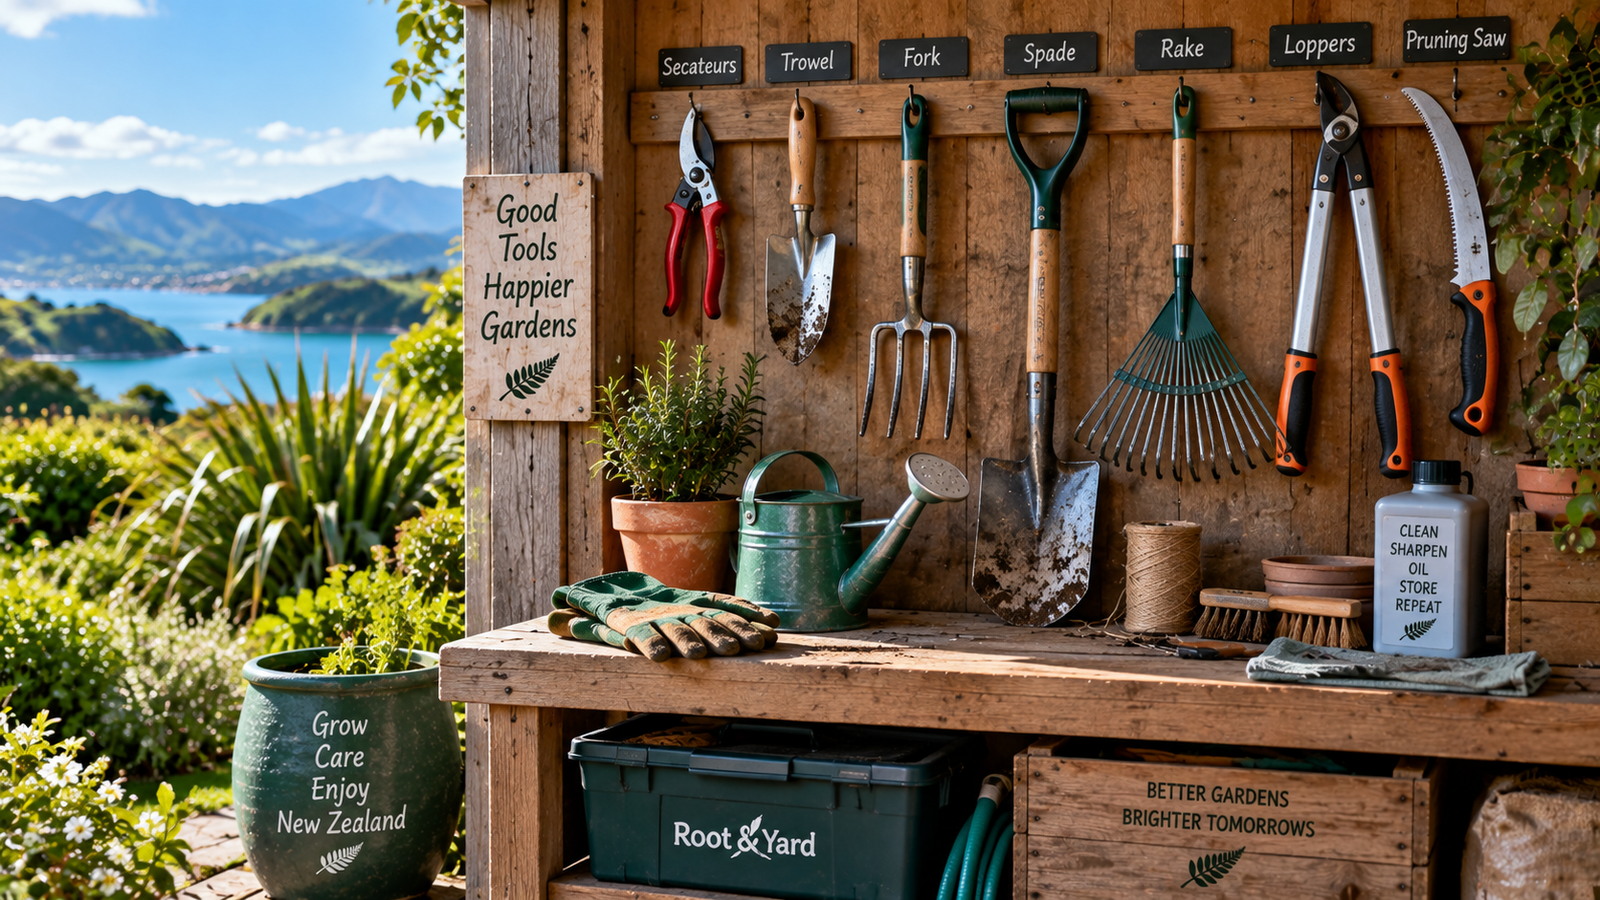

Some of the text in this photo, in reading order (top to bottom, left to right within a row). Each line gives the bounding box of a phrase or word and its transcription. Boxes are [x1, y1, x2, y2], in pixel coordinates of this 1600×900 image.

[1162, 37, 1203, 58] Rake
[1285, 35, 1355, 60] Loppers
[1407, 28, 1506, 54] Pruning Saw
[663, 58, 736, 75] Secateurs
[781, 50, 833, 71] Trowel
[905, 46, 940, 67] Fork
[1024, 41, 1075, 67] Spade
[497, 193, 558, 227] Good
[499, 232, 557, 262] Tools
[484, 272, 574, 307] Happier
[481, 310, 576, 344] Gardens
[1400, 524, 1438, 538] CLEAN
[1390, 542, 1447, 558] SHARPEN
[1409, 562, 1428, 575] OIL
[1400, 580, 1437, 594] STORE
[1396, 598, 1442, 613] REPEAT
[312, 711, 368, 738] Grow
[316, 744, 364, 768] Care
[312, 777, 369, 807] Enjoy
[1148, 782, 1288, 807] BETTER GARDENS
[278, 804, 407, 834] New Zealand
[1123, 809, 1315, 837] BRIGHTER TOMORROWS
